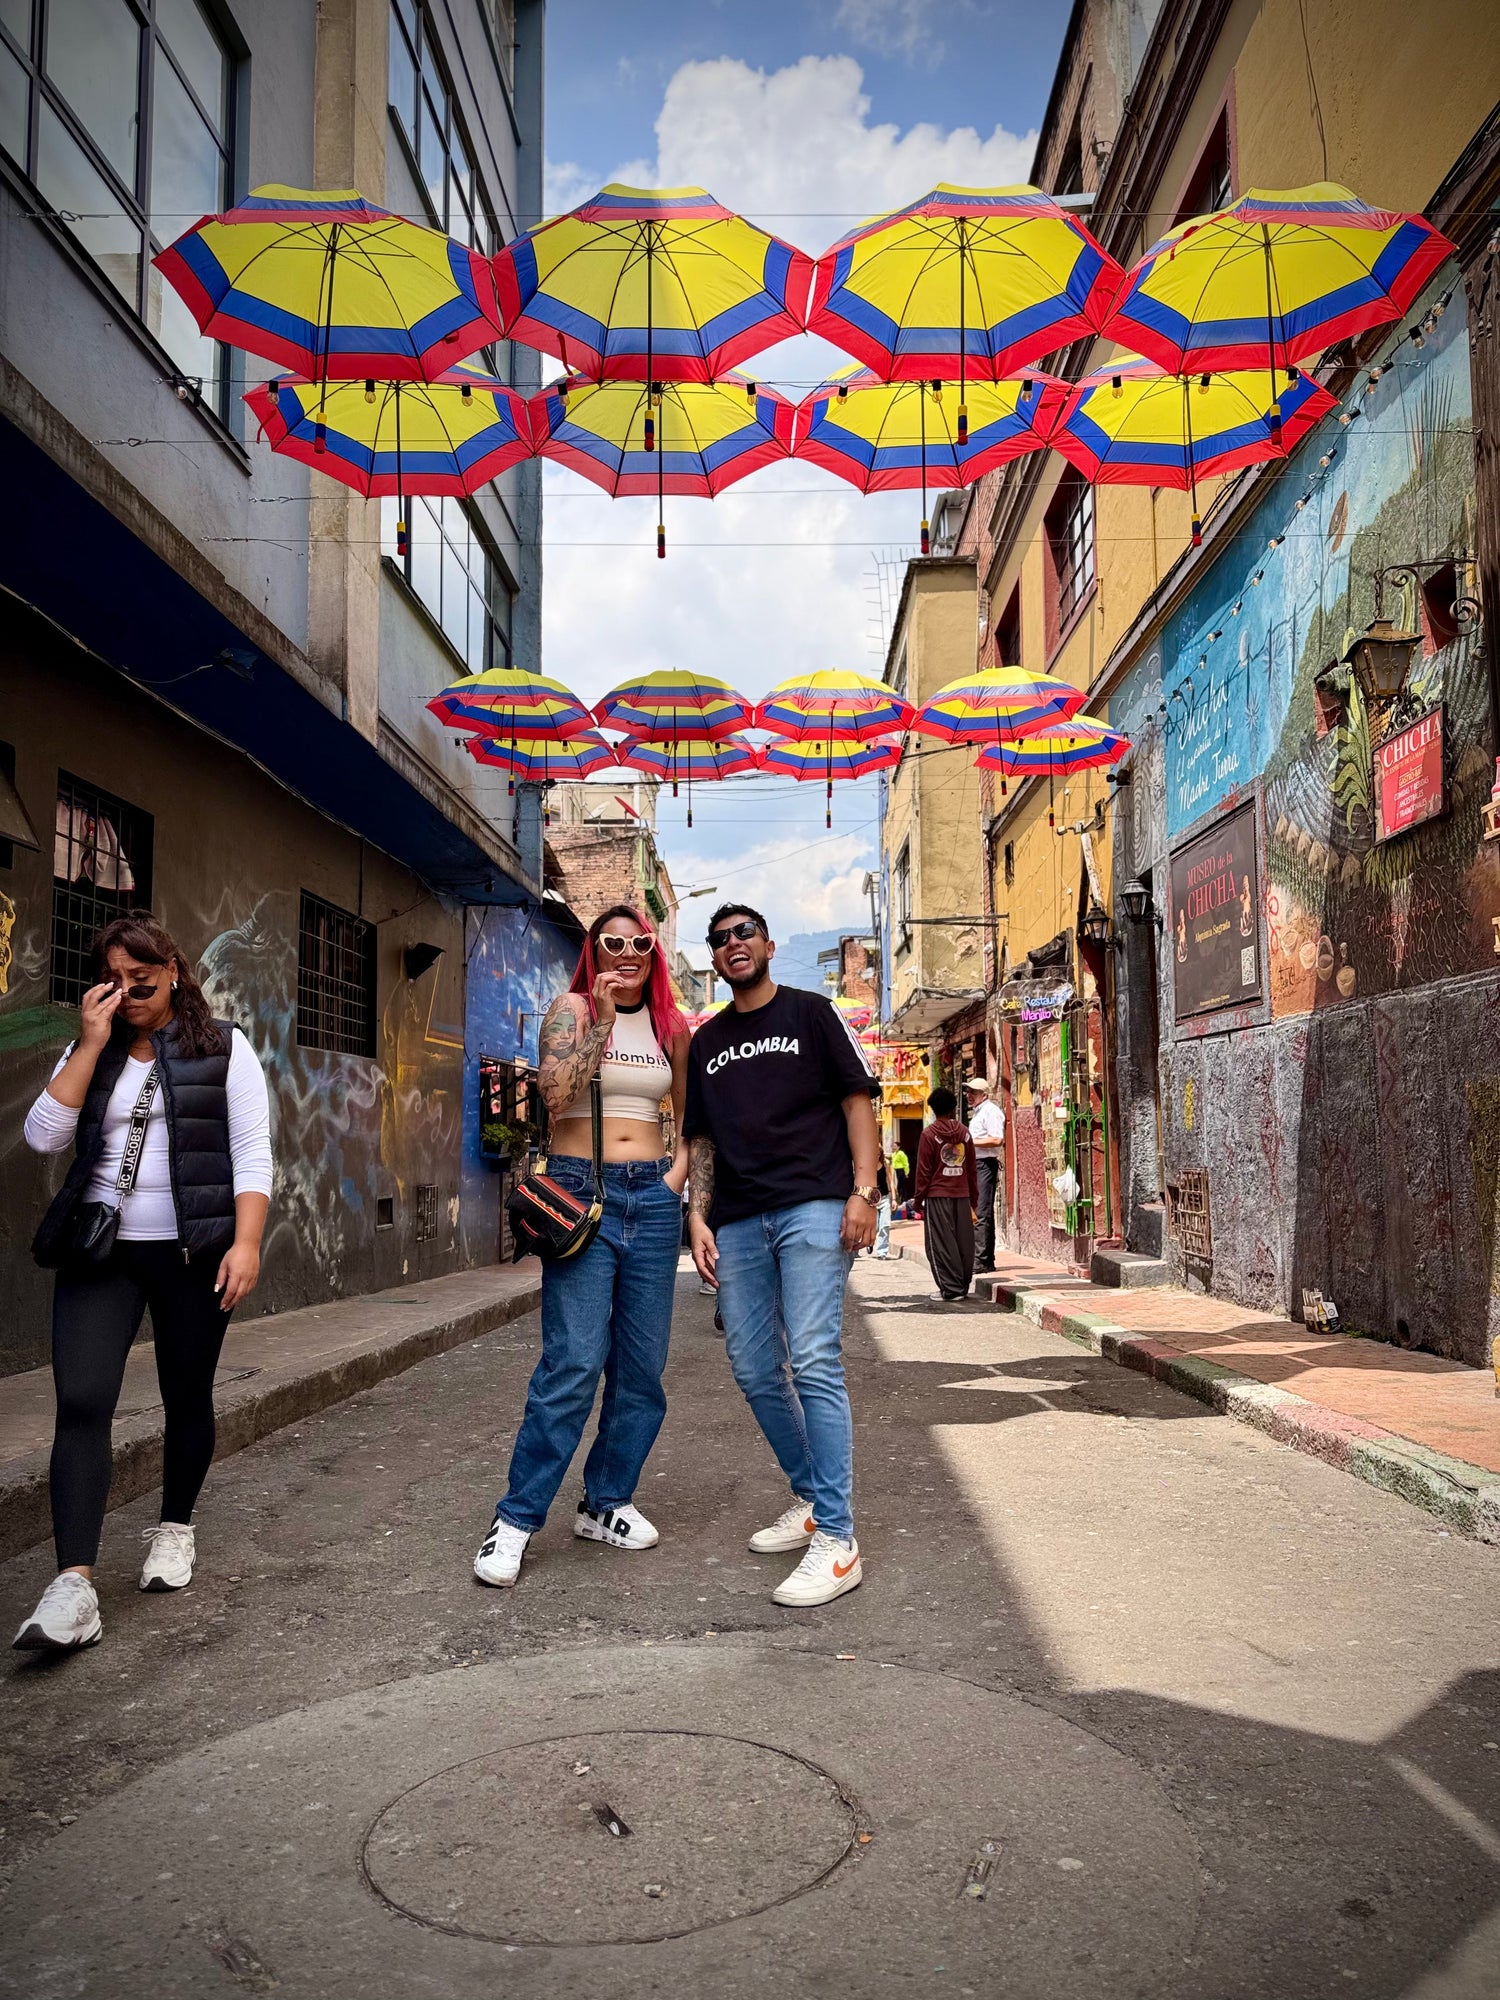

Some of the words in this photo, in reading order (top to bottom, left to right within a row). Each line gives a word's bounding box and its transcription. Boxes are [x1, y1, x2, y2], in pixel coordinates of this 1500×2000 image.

[1383, 714, 1442, 768] CHICHA
[1176, 753, 1186, 783] El
[1178, 768, 1210, 814] Madre
[1212, 746, 1241, 785] Tierra
[1187, 855, 1216, 889] MUSEO
[1217, 855, 1226, 870] de
[1226, 850, 1233, 866] la
[1187, 870, 1238, 920] CHICHA
[604, 1050, 668, 1067] olombia
[706, 1036, 800, 1075] COLOMBIA
[125, 1126, 143, 1171] JACOBS
